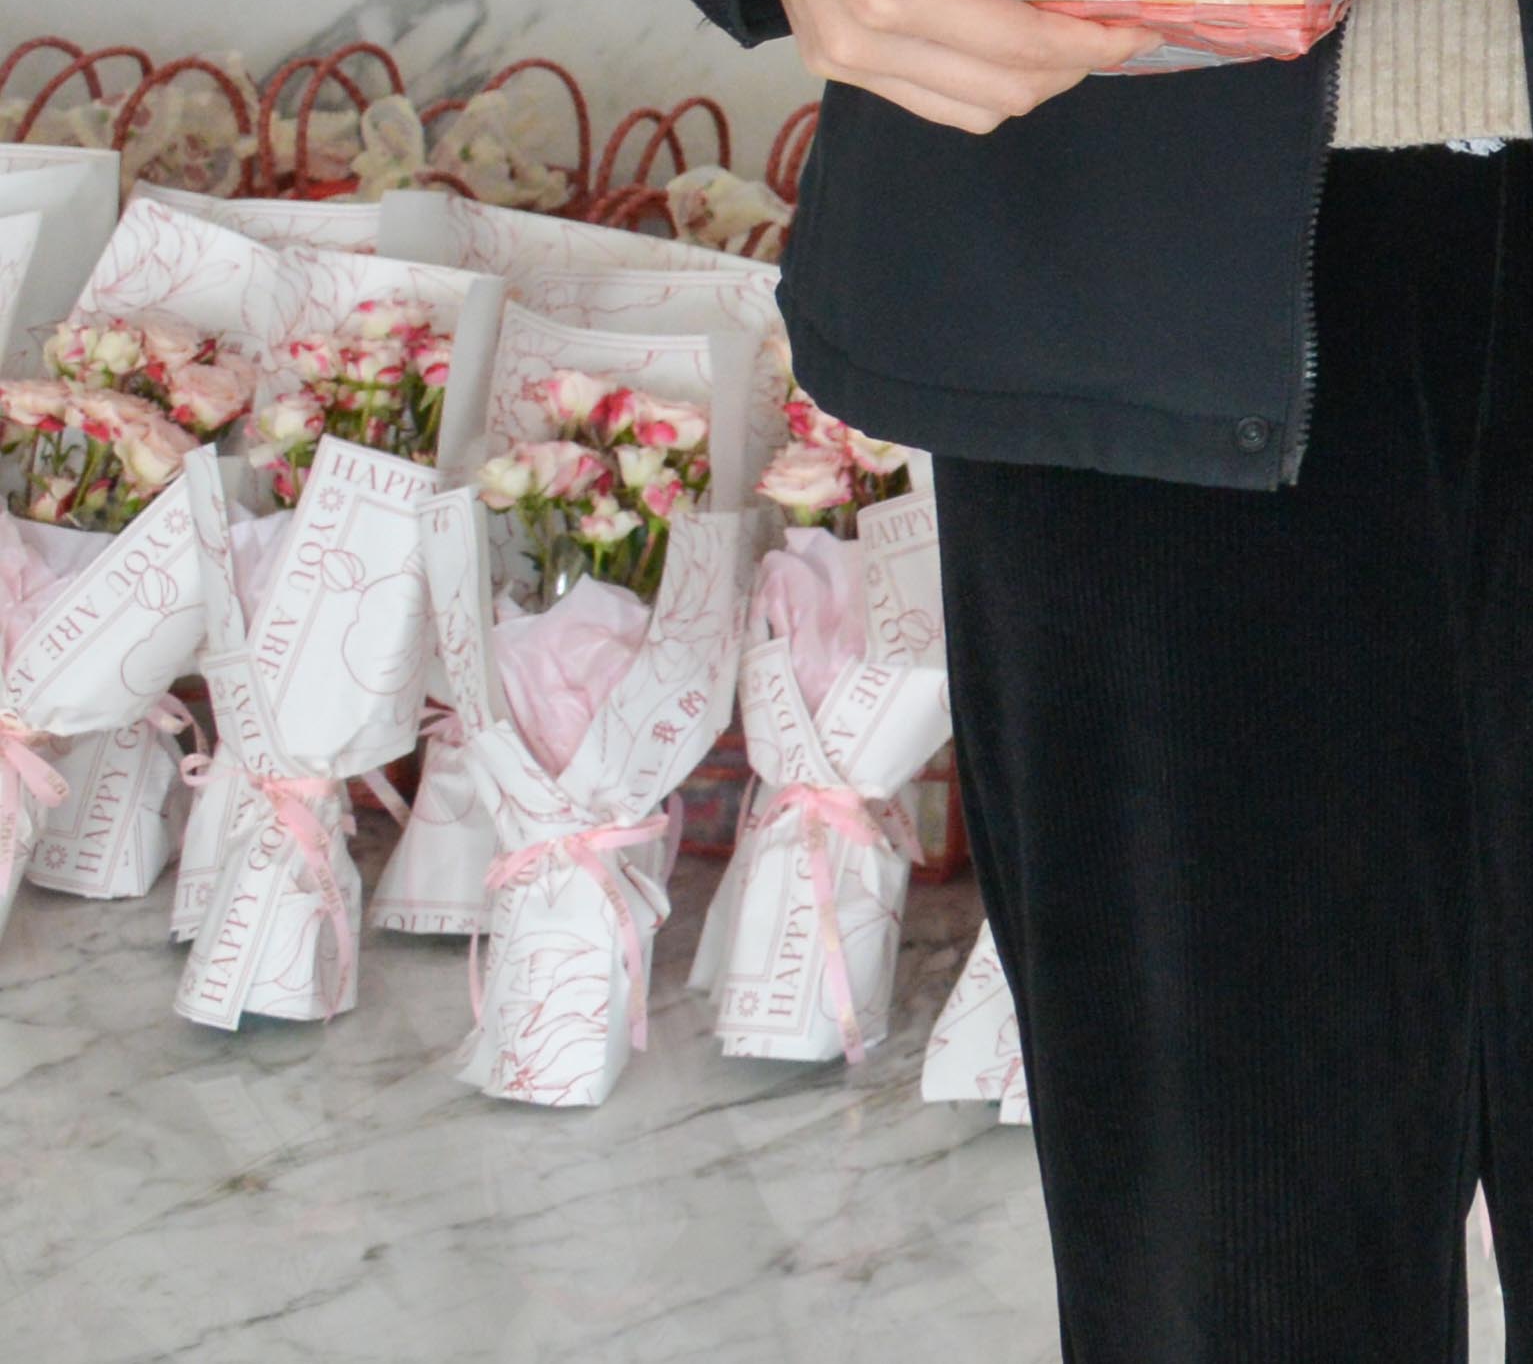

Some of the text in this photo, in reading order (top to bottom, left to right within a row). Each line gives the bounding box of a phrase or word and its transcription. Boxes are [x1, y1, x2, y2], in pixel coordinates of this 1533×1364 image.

[104, 533, 171, 598] YOU
[287, 521, 336, 594] YOU
[40, 595, 99, 661] ARE
[75, 769, 128, 874] HAPPY
[199, 891, 258, 1005] HAPPY
[767, 897, 814, 1017] HAPPY
